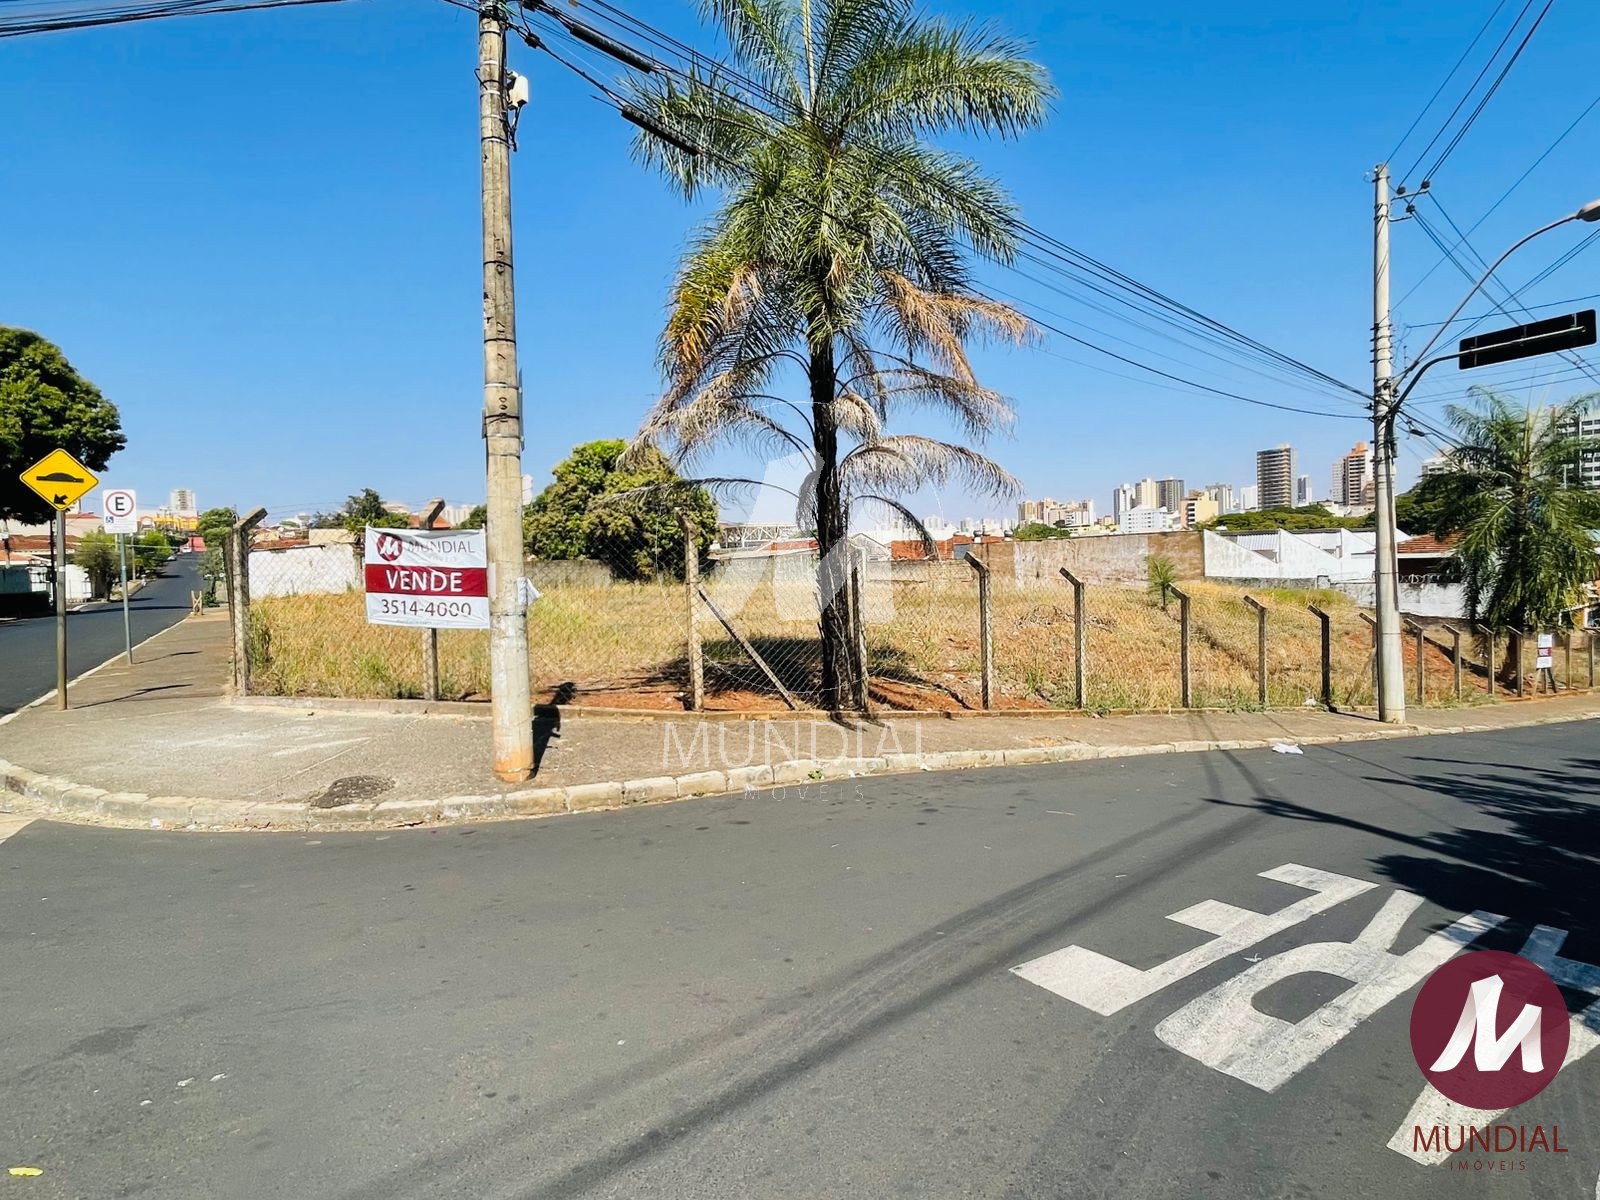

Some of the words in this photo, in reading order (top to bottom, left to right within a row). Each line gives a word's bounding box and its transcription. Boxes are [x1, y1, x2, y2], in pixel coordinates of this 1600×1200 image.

[115, 496, 125, 511] E
[385, 569, 463, 593] VENDE
[381, 598, 472, 617] 3514-4000
